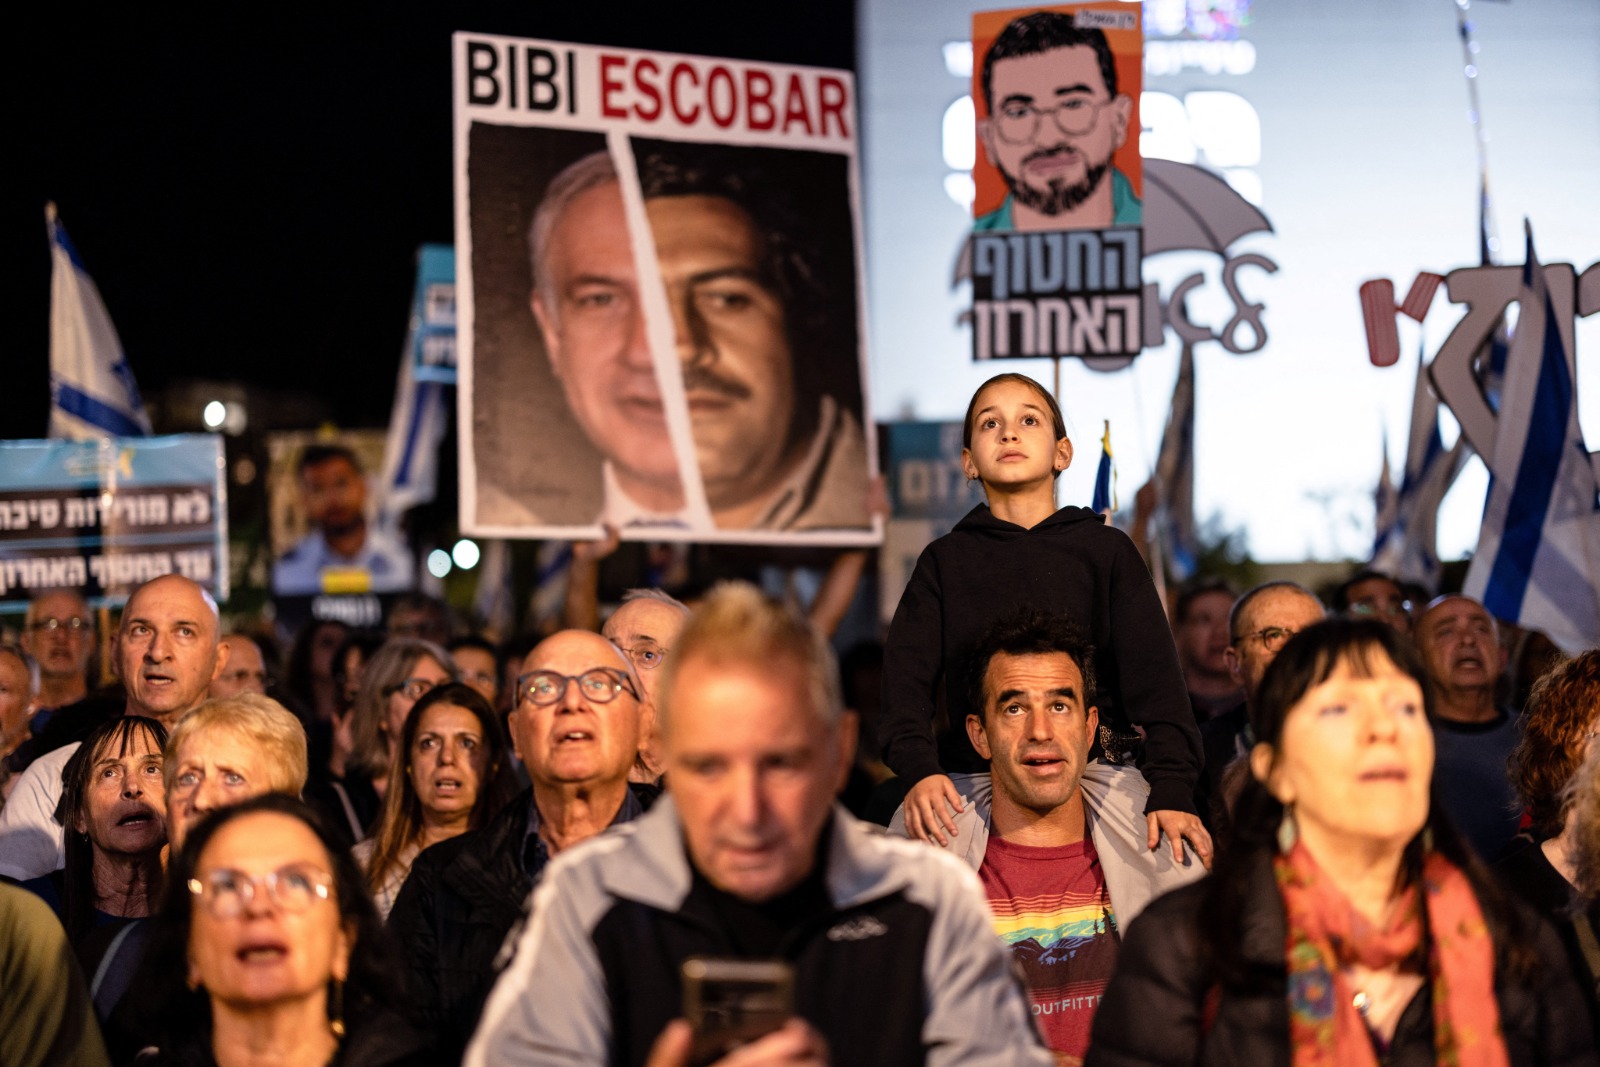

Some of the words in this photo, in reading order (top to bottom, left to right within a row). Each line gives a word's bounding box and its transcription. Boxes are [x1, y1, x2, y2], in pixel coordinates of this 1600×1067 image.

[466, 40, 578, 115] BIBI
[598, 53, 851, 139] ESCOBAR
[974, 229, 1141, 300] החטוף
[974, 294, 1141, 360] האחרון
[172, 489, 211, 524] לא
[0, 556, 87, 596] האחרון
[89, 552, 173, 589] החטוף
